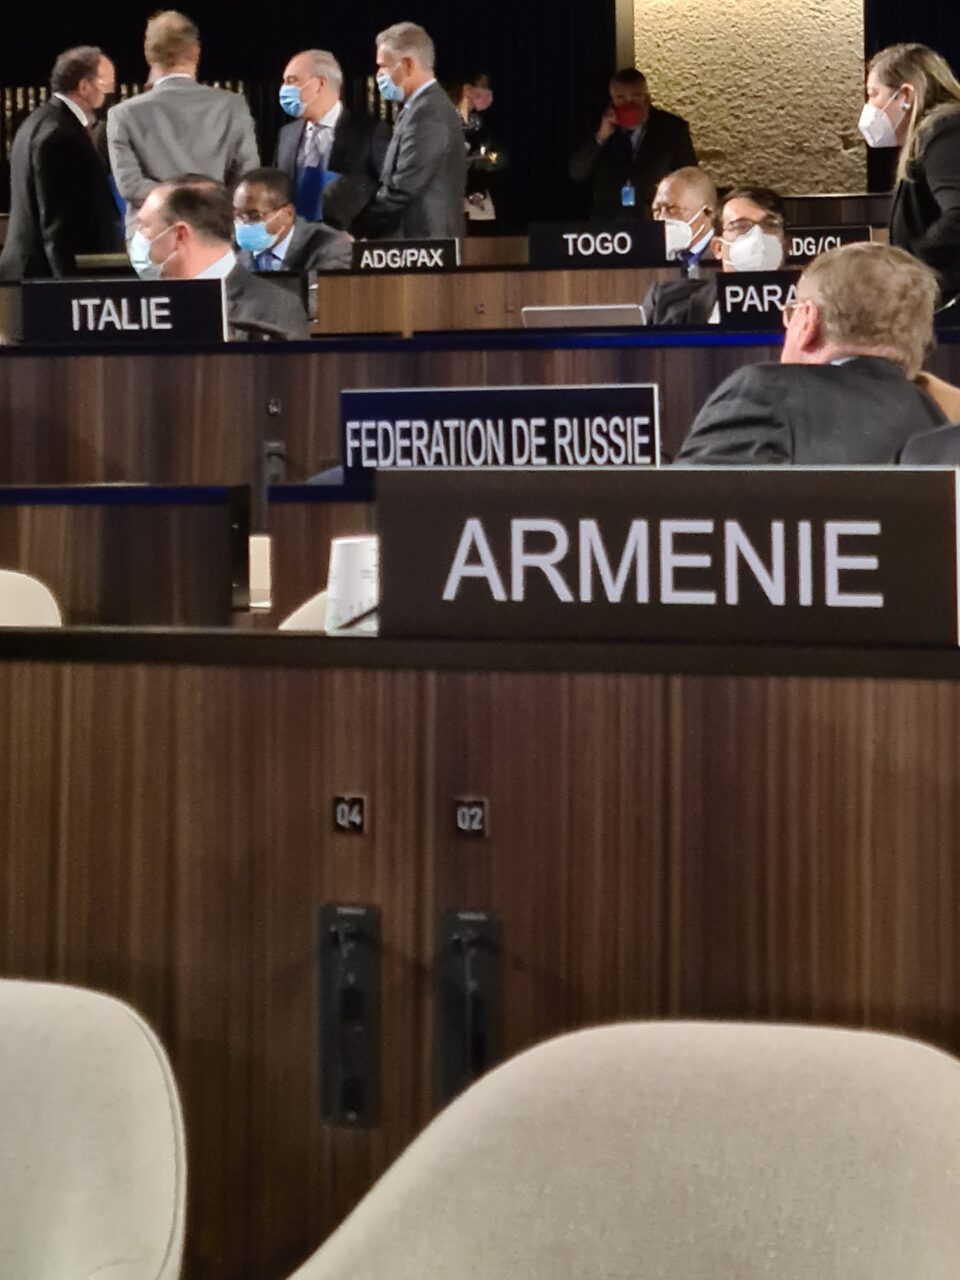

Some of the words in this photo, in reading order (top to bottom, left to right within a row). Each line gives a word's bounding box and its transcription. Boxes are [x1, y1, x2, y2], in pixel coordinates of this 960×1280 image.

[562, 232, 632, 256] TOGO
[360, 248, 443, 268] ADG/PAX
[71, 296, 173, 331] ITALIE
[346, 419, 505, 467] FEDERATION
[512, 418, 547, 465] DE
[554, 416, 651, 465] RUSSIE
[442, 518, 884, 608] ARMENIE
[336, 803, 362, 828] 04
[456, 806, 483, 831] 02
